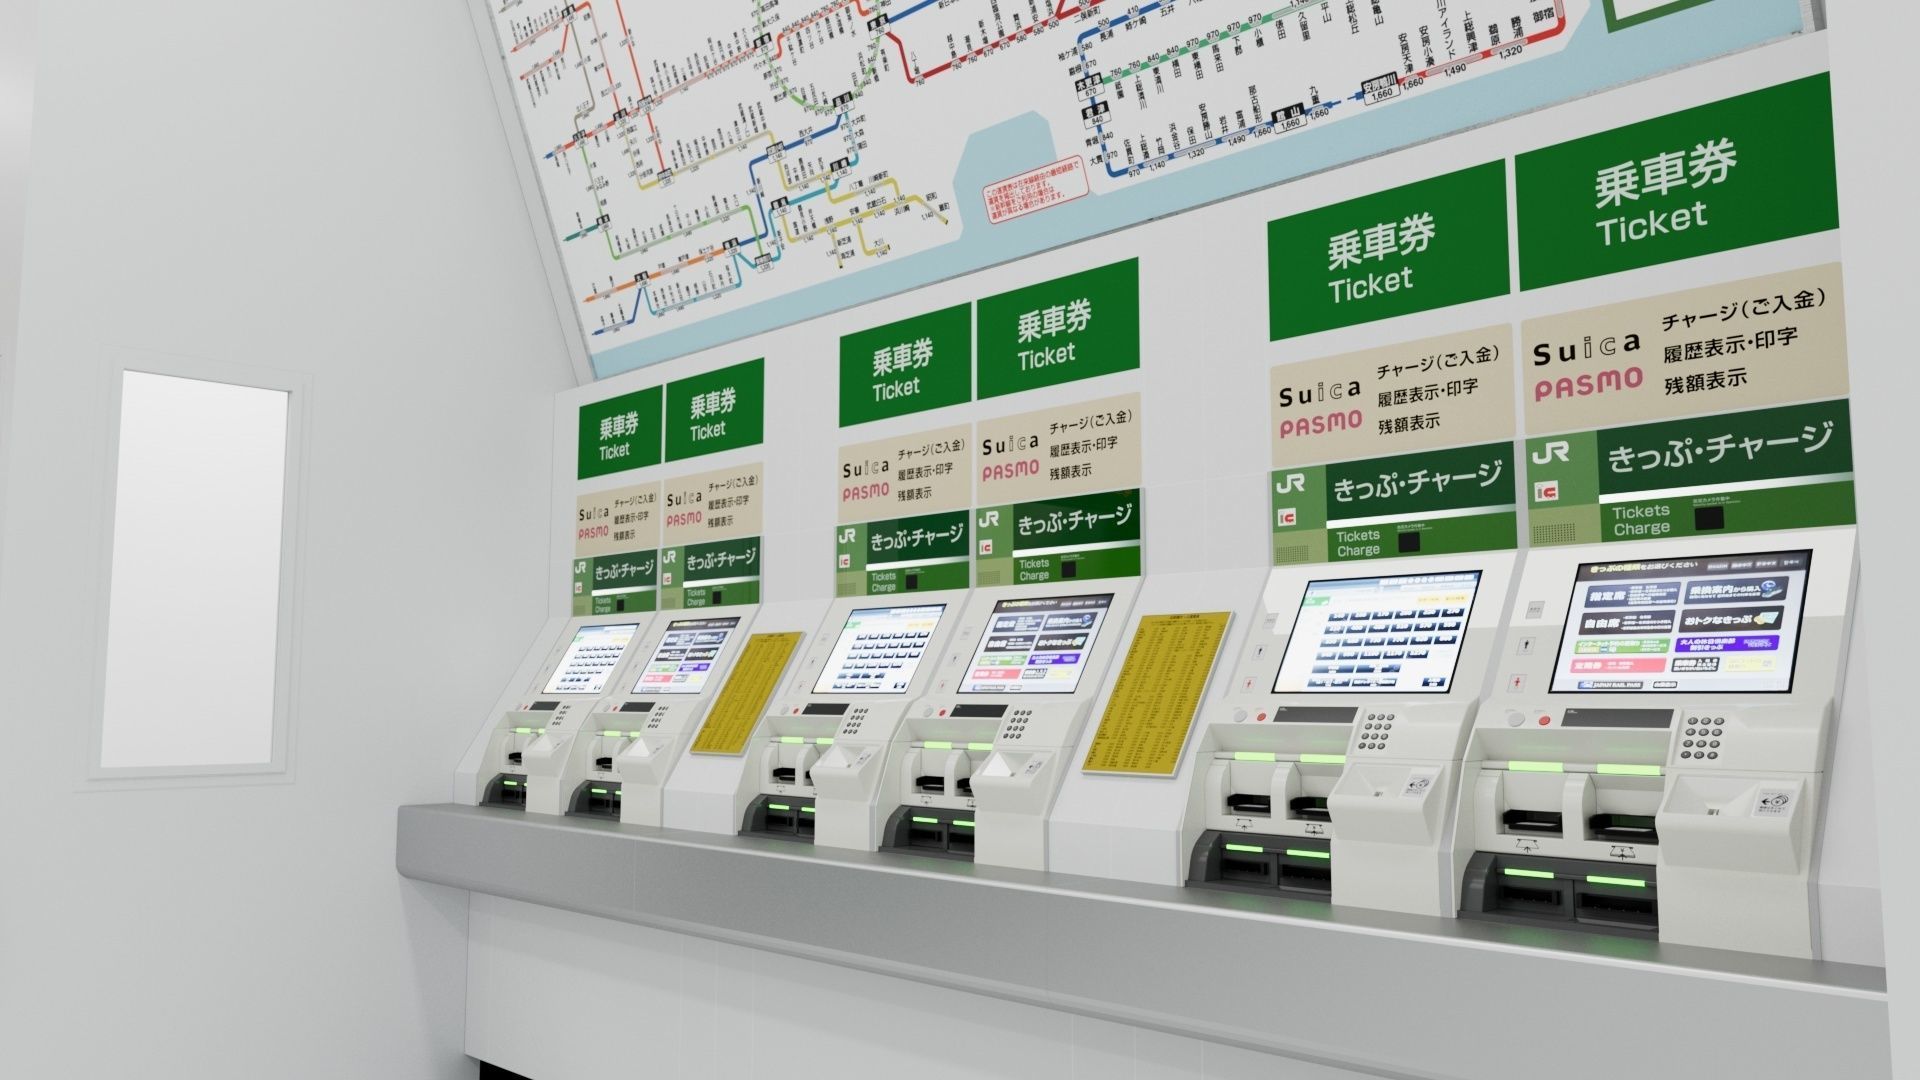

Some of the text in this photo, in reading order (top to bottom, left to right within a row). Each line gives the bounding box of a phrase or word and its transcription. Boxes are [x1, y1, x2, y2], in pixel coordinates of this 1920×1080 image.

[1074, 6, 1100, 23] 二俣新町
[1127, 5, 1139, 15] 410
[1160, 4, 1175, 17] 五井
[1248, 13, 1262, 23] 970
[1320, 2, 1332, 23] 平山
[1533, 7, 1555, 23] 御宿
[1048, 20, 1060, 30] 500
[1098, 17, 1110, 27] 500
[1227, 21, 1241, 32] 970
[1275, 19, 1286, 40] 俵田
[1298, 11, 1311, 41] 久留里
[1511, 15, 1524, 38] 勝浦
[1100, 29, 1114, 42] 長浦
[1206, 29, 1220, 40] 970
[1463, 11, 1478, 53] 上総興津
[1000, 41, 1010, 50] 670
[1082, 42, 1093, 52] 580
[1166, 45, 1179, 55] 840
[1186, 37, 1199, 48] 970
[1419, 25, 1435, 67] 安房小湊
[984, 48, 994, 58] 670
[1147, 52, 1160, 63] 840
[1211, 44, 1224, 72] 馬来田
[1398, 33, 1414, 74] 安房天津
[1499, 45, 1523, 60] 1,320
[1085, 59, 1097, 69] 670
[1128, 60, 1141, 69] 760
[1172, 59, 1182, 78] 横田
[1192, 51, 1203, 80] 東横田
[1444, 63, 1467, 77] 1,490
[1085, 88, 1097, 97] 670
[1402, 77, 1424, 91] 1,660
[1309, 85, 1320, 105] 九重
[1372, 89, 1393, 101] 1,660
[1310, 108, 1329, 120] 1,660
[1253, 127, 1272, 138] 1,660
[1281, 118, 1300, 130] 1,660
[1102, 132, 1114, 141] 840
[1187, 126, 1196, 145] 保田
[1228, 134, 1246, 146] 1,490
[1106, 150, 1118, 160] 970
[1188, 148, 1205, 159] 1,320
[1128, 168, 1141, 178] 970
[1150, 160, 1166, 172] 1,140
[1595, 137, 1738, 211] 乗車券
[1596, 201, 1708, 248] Ticket
[1328, 212, 1436, 272] 乗車券
[1328, 266, 1414, 304] Ticket
[1662, 287, 1826, 332] チャージ（ご入金）
[1017, 297, 1092, 344] 乗車券
[1533, 333, 1641, 367] Suica
[1664, 326, 1799, 365] 履歴表示・印字
[873, 336, 934, 378] 乗車券
[1017, 342, 1076, 371] Ticket
[1377, 344, 1500, 380] チャージ（ご入金）
[872, 376, 921, 402] Ticket
[1535, 366, 1643, 402] PASMO
[1665, 367, 1748, 396] 残額表示
[1279, 380, 1361, 408] Suica
[1378, 377, 1479, 408] 履歴表示・印字
[690, 386, 736, 420] 乗車券
[599, 410, 639, 441] 乗車券
[690, 420, 726, 441] Ticket
[1049, 408, 1133, 435] チャージ（ご入金）
[1280, 409, 1363, 439] PASMO
[1378, 412, 1441, 436] 残額表示
[599, 441, 630, 461] Ticket
[898, 438, 966, 461] チャージ（ご入金）
[982, 433, 1039, 456] Suica
[1049, 435, 1119, 459] 履歴表示・印字
[1532, 440, 1570, 465] JR
[1608, 420, 1835, 474] きっぷ・チャージ
[843, 458, 890, 479] Suica
[898, 461, 953, 482] 履歴表示・印字
[982, 459, 1040, 482] PASMO
[1050, 462, 1093, 482] 残額表示
[708, 474, 759, 493] チャージ（ご入金）
[1276, 472, 1305, 494] JR
[1334, 459, 1503, 503] きっぷ・チャージ
[667, 491, 702, 507] Suica
[843, 482, 890, 502] PASMO
[898, 486, 933, 502] 残額表示
[579, 505, 609, 522] Suica
[666, 510, 703, 529] PASMO
[978, 510, 999, 528] JR
[1018, 503, 1133, 536] きっぷ・チャージ
[1612, 503, 1670, 519] Tickets
[578, 524, 609, 541] PASMO
[839, 528, 856, 543] JR
[871, 523, 964, 552] きっぷ・チャージ
[1336, 530, 1381, 543] Tickets
[1614, 520, 1671, 537] Charge
[663, 550, 676, 565] JR
[687, 547, 757, 572] きっぷ・チャージ
[1337, 545, 1381, 558] Charge
[574, 561, 587, 574] JR
[595, 559, 654, 581] きっぷ・チャージ
[1020, 557, 1050, 570] Tickets
[872, 571, 897, 582] Tickets
[1019, 569, 1050, 582] Charge
[872, 582, 897, 593] Charge
[1584, 619, 1620, 629] 自由席
[1684, 614, 1753, 626] おトクなきっぷ
